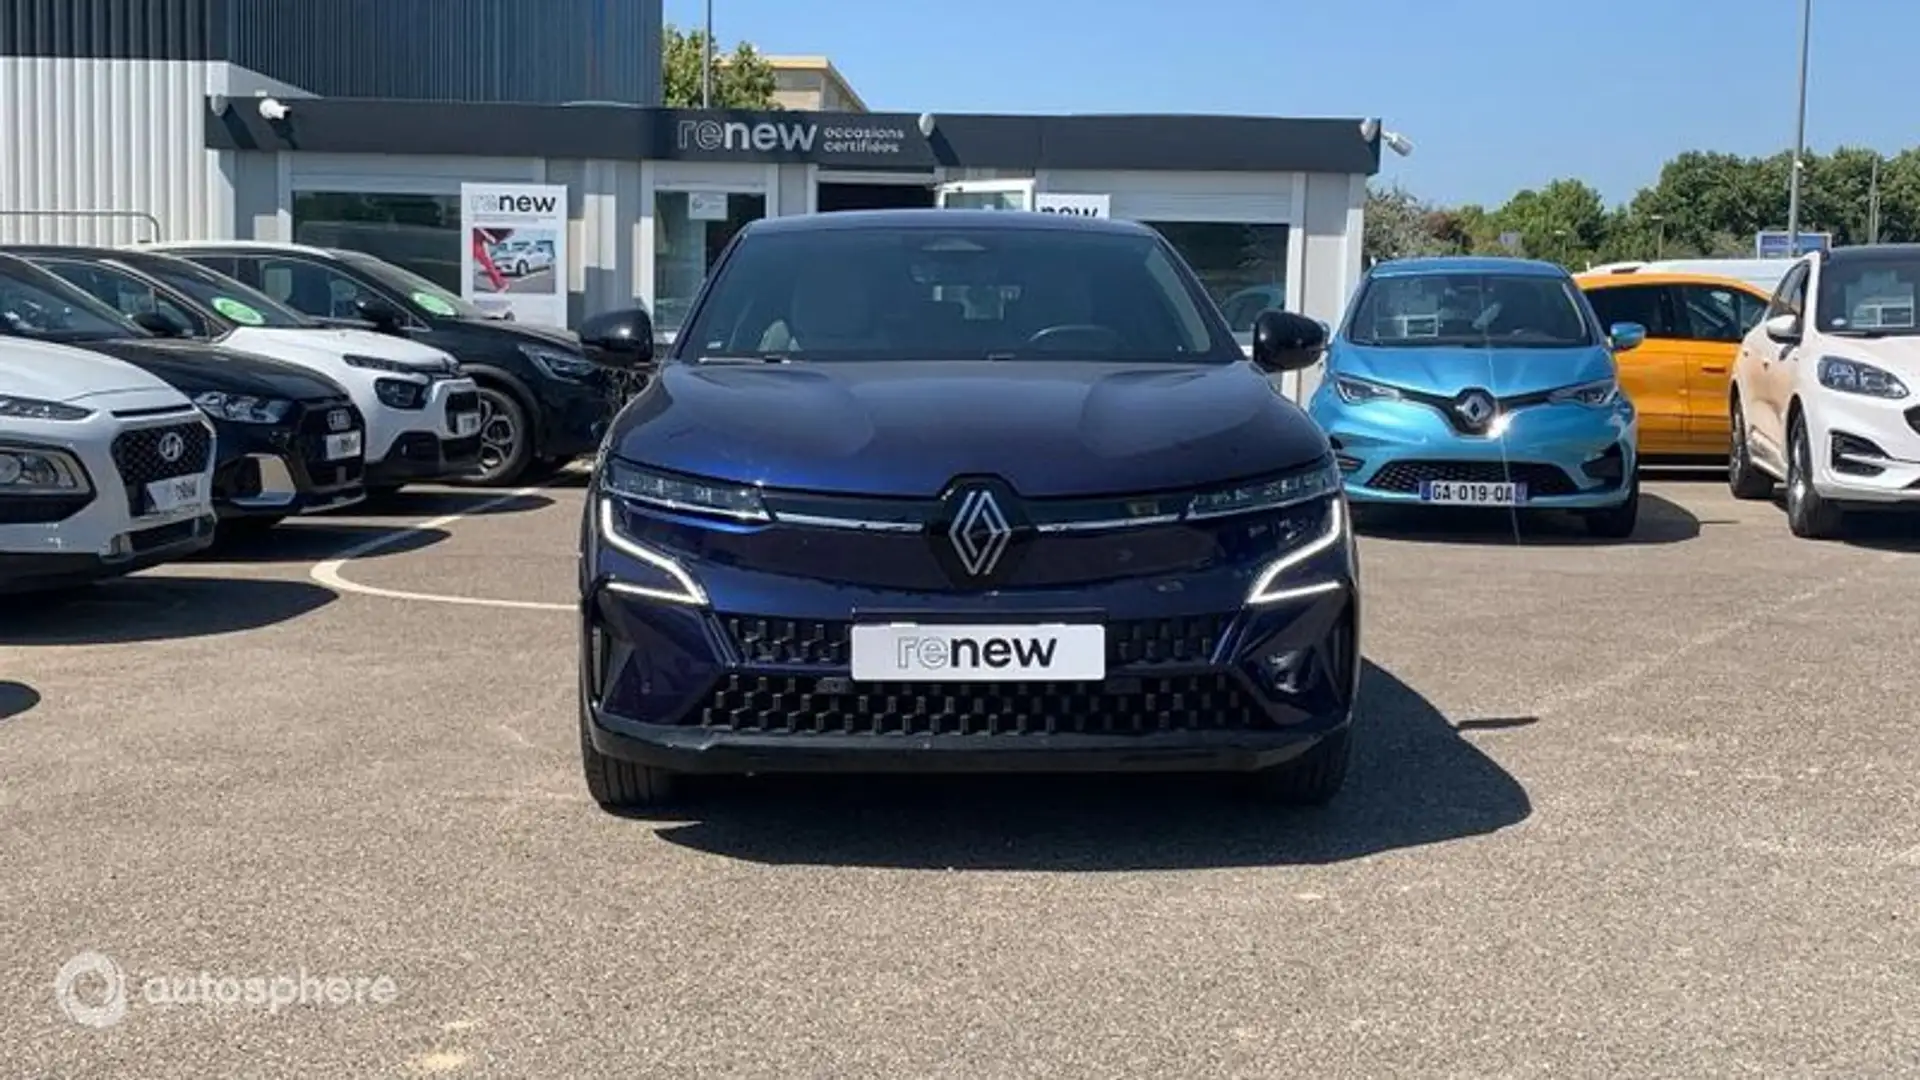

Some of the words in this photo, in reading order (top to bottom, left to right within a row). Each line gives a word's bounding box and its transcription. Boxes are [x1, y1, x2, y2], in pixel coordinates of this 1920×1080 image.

[677, 120, 818, 150] renew
[823, 126, 904, 140] occasions
[897, 636, 1058, 670] renew
